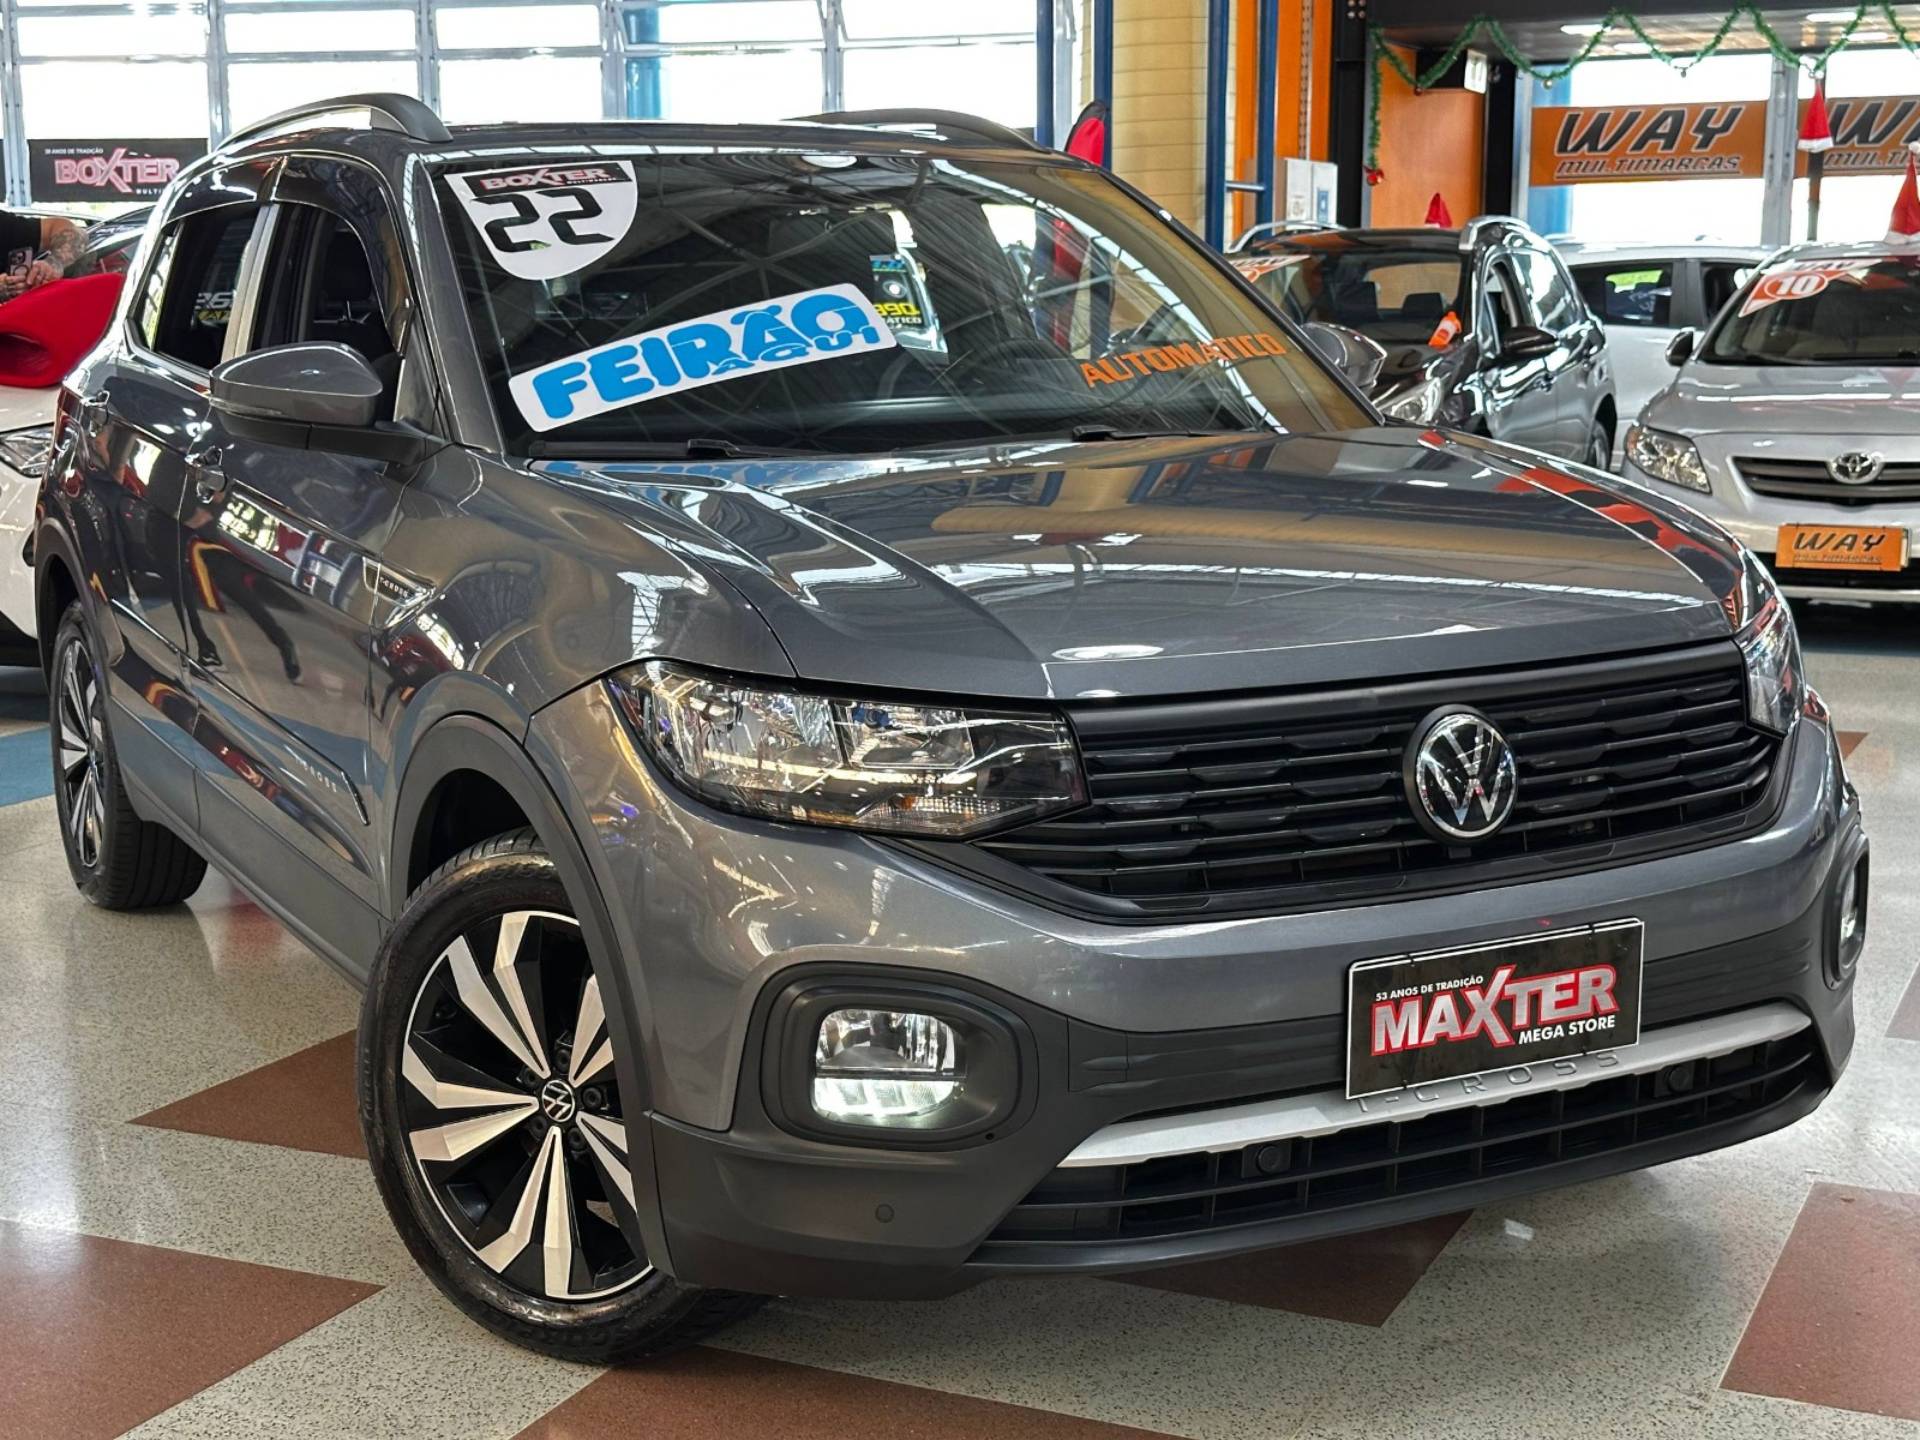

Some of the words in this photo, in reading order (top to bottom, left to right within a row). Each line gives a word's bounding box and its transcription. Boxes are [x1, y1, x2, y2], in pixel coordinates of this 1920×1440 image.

[1555, 105, 1745, 155] WAY
[54, 148, 179, 193] BOXTER
[1556, 155, 1742, 174] MULTIMARCAS
[1823, 151, 1909, 168] MULTI
[135, 187, 162, 195] MULTI
[480, 168, 610, 191] BOXTER
[470, 187, 615, 253] 22
[1775, 275, 1821, 296] 10
[532, 293, 870, 420] FEIRÃO
[711, 326, 881, 376] AQUI
[1793, 532, 1886, 552] WAY
[1375, 992, 1388, 1002] 53
[1390, 986, 1418, 999] ANOS
[1421, 983, 1433, 994] DE
[1435, 974, 1484, 990] TRADIÇÃO
[1370, 964, 1620, 1056] MAXTER
[1518, 1026, 1564, 1046] MEGA
[1568, 1015, 1616, 1036] STORE
